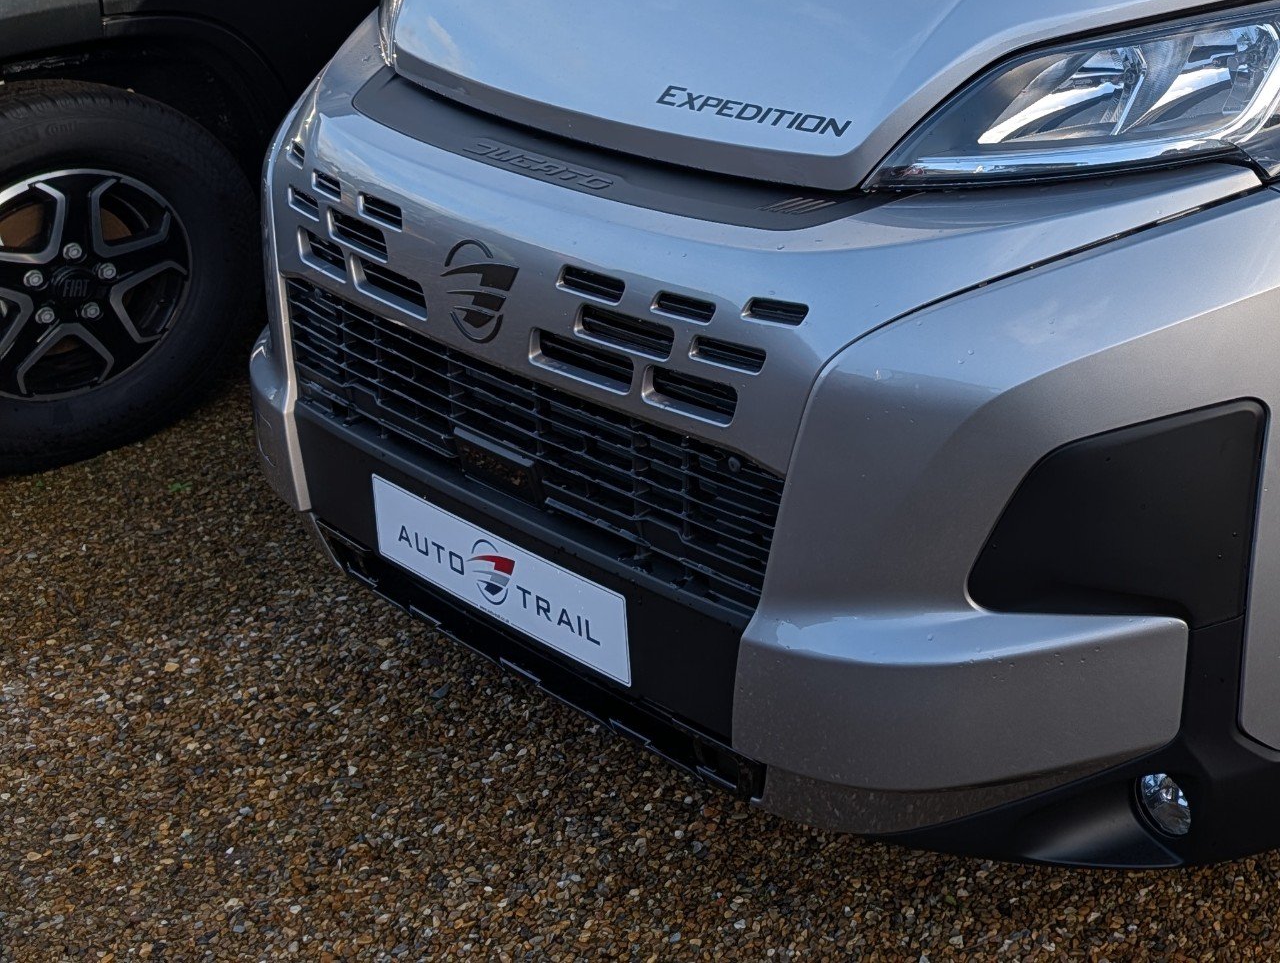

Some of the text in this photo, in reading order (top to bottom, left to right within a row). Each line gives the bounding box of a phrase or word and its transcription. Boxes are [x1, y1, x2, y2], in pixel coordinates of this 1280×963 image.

[656, 84, 852, 138] EXPEDITION
[461, 138, 615, 191] DUCATO
[62, 278, 91, 298] FIAT
[397, 524, 601, 647] AUTO TRAIL
